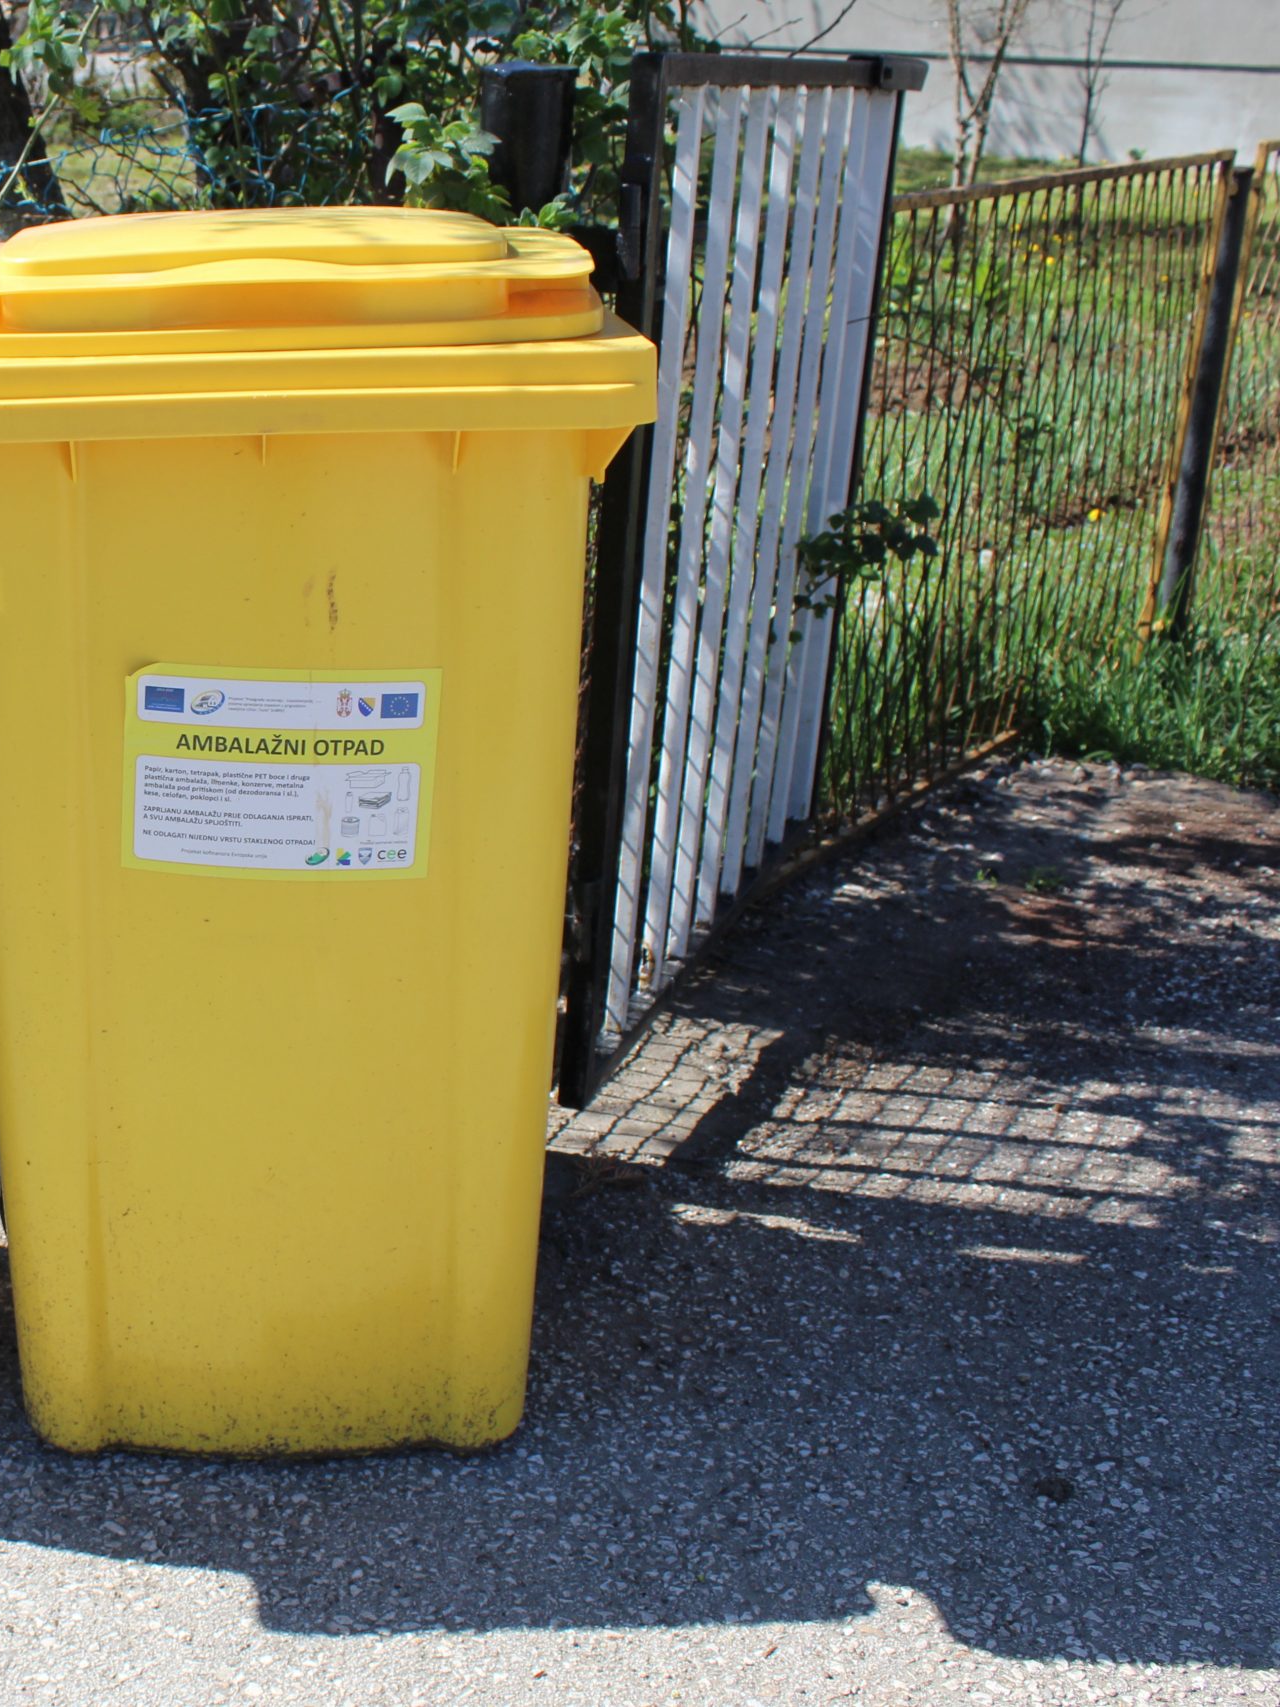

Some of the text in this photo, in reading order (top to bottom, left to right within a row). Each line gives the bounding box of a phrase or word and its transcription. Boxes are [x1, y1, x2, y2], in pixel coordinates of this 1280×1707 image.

[176, 734, 384, 756] AMBALAŽNI OTPAD
[145, 765, 163, 773] Papir,
[190, 769, 221, 778] tetrapak,
[176, 776, 209, 785] ambalaža,
[211, 779, 239, 787] limenke,
[144, 805, 181, 814] ZAPRLJANU
[183, 809, 221, 817] AMBALAŽU
[165, 816, 203, 824] AMBALAŽU
[153, 830, 187, 838] ODLAGATI
[377, 849, 407, 860] cee
